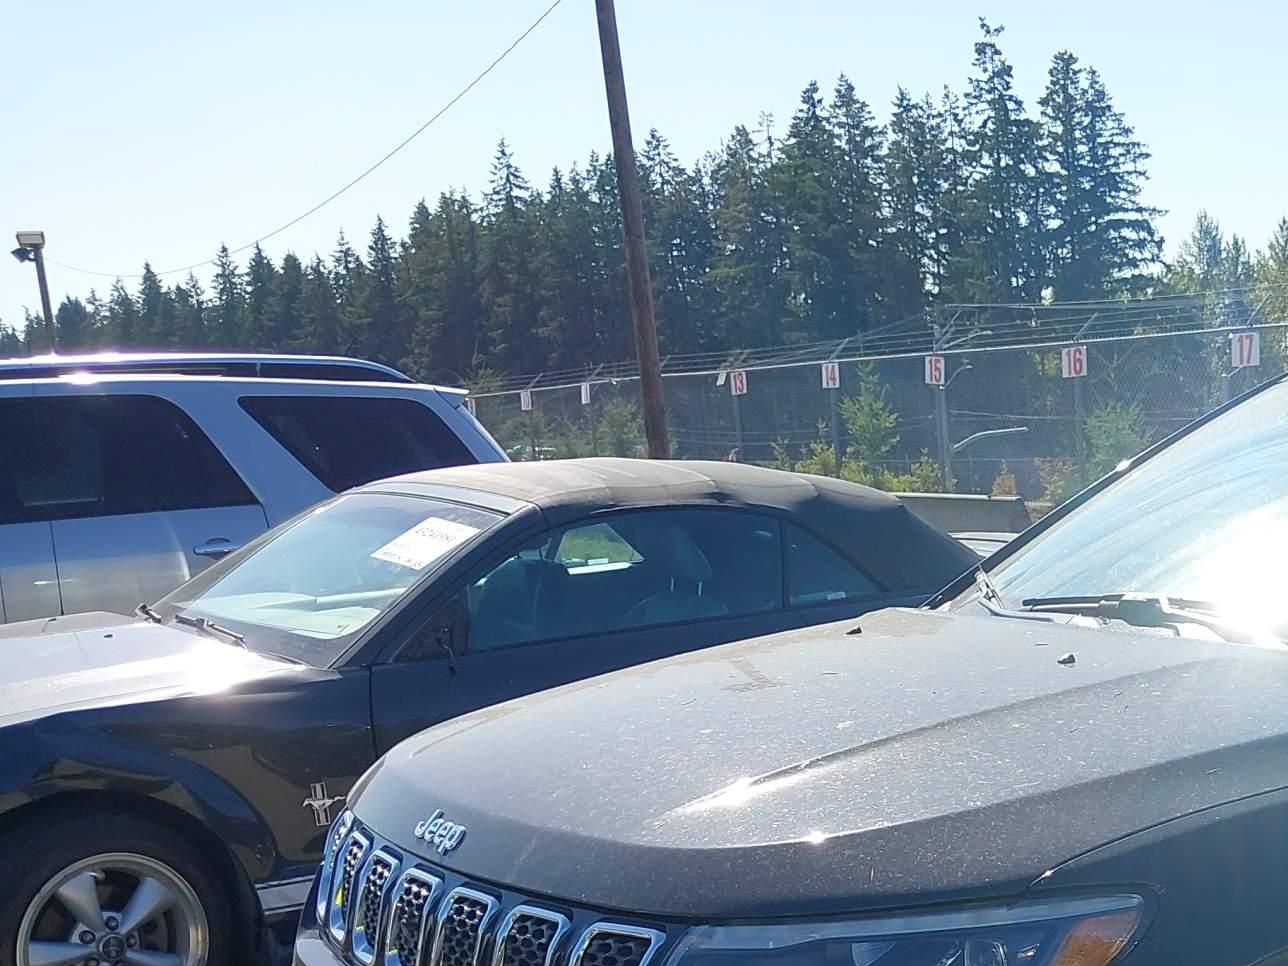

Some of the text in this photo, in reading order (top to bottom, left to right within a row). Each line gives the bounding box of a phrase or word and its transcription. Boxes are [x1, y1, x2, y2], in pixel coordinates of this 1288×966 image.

[1065, 347, 1083, 376] 16
[1237, 334, 1254, 365] 17
[733, 372, 745, 393] 13
[824, 365, 838, 386] 14
[928, 358, 942, 383] 15
[414, 808, 466, 853] Jeep
